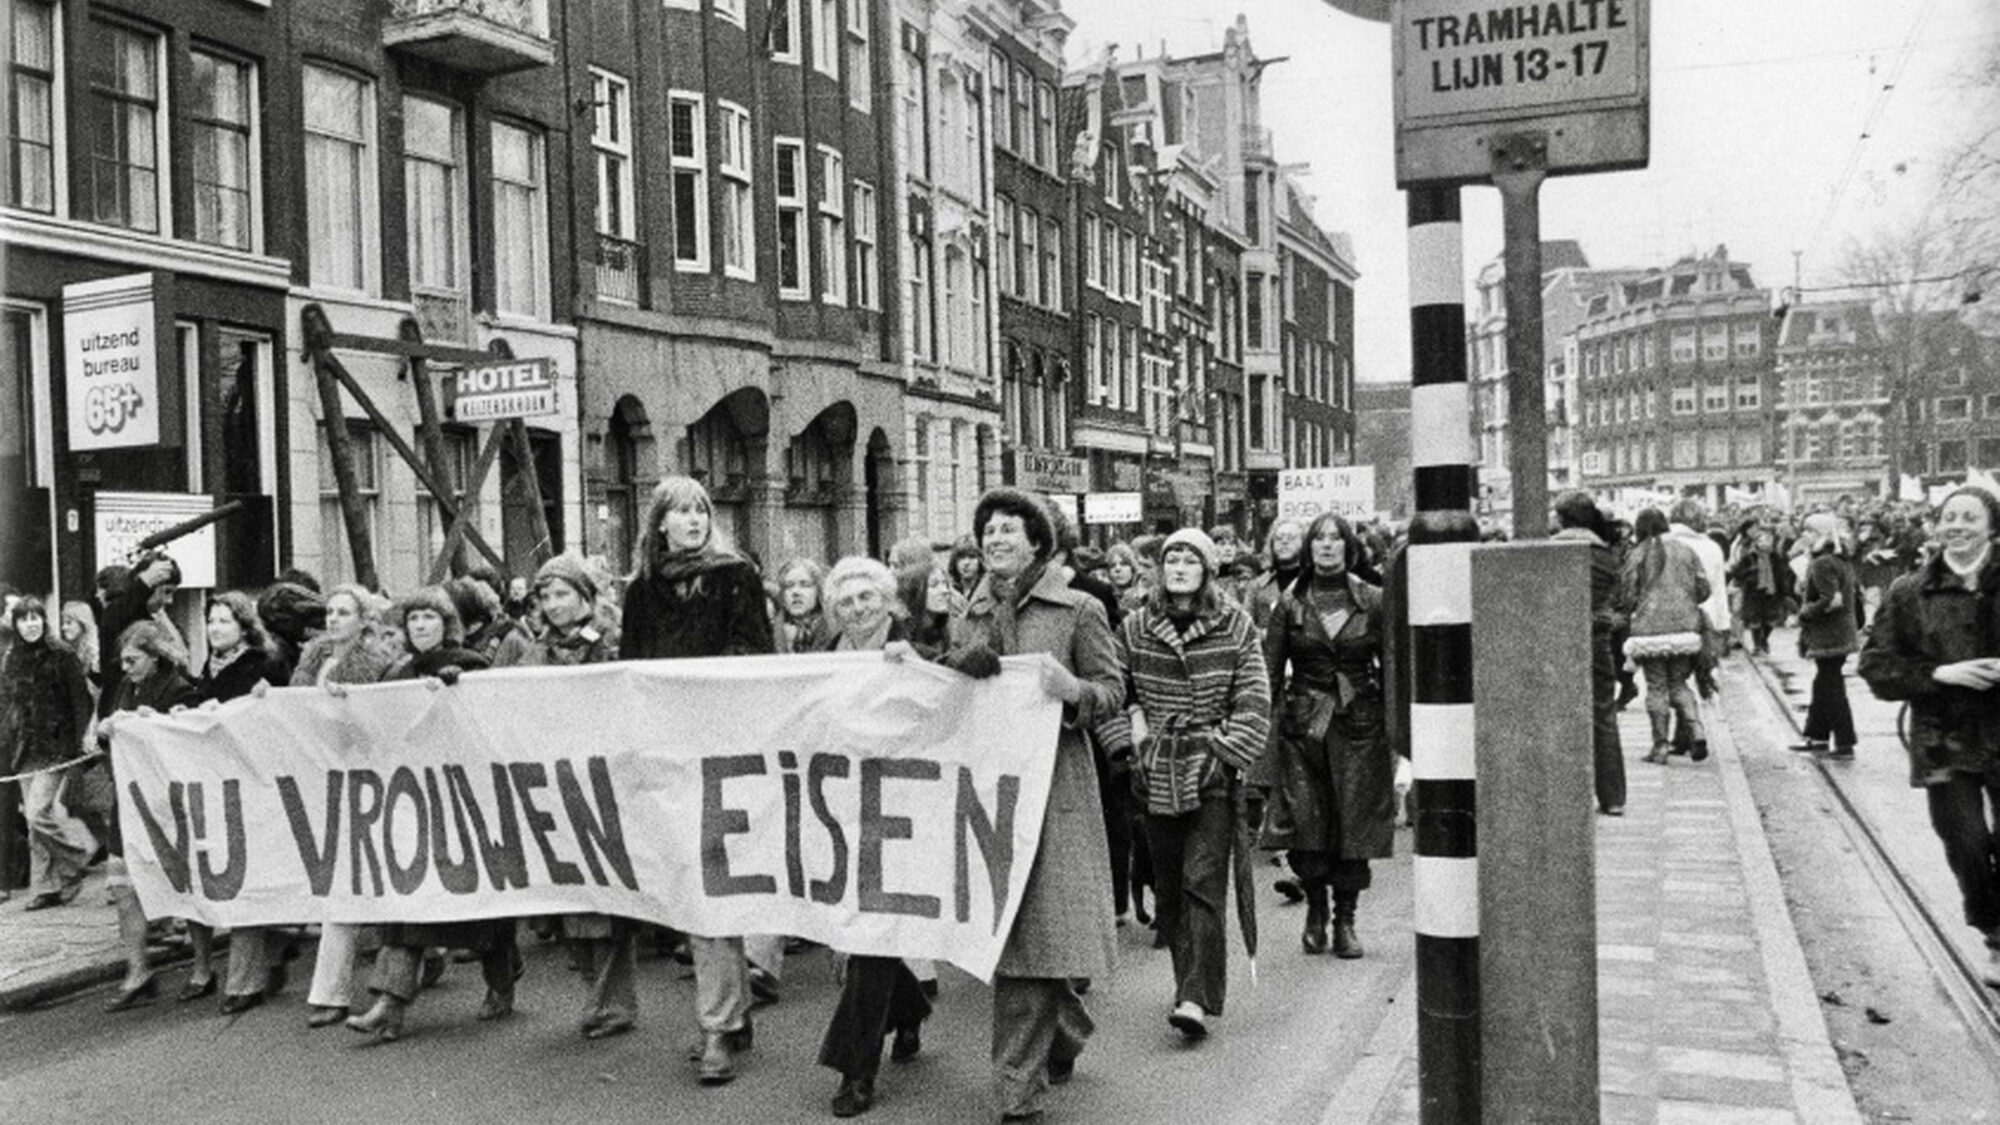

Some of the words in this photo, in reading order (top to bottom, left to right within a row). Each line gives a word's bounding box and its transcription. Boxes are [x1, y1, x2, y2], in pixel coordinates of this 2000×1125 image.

[1412, 0, 1627, 49] TRAMHALTE
[1432, 53, 1503, 92] LIJN
[1514, 41, 1609, 83] 13-17
[81, 326, 139, 352] uitzend
[83, 355, 140, 376] bureau
[457, 364, 549, 392] HOTEL
[84, 383, 143, 435] 65+
[1284, 474, 1325, 491] BAAS
[1334, 473, 1350, 487] IN
[276, 756, 639, 897] VROUWEN
